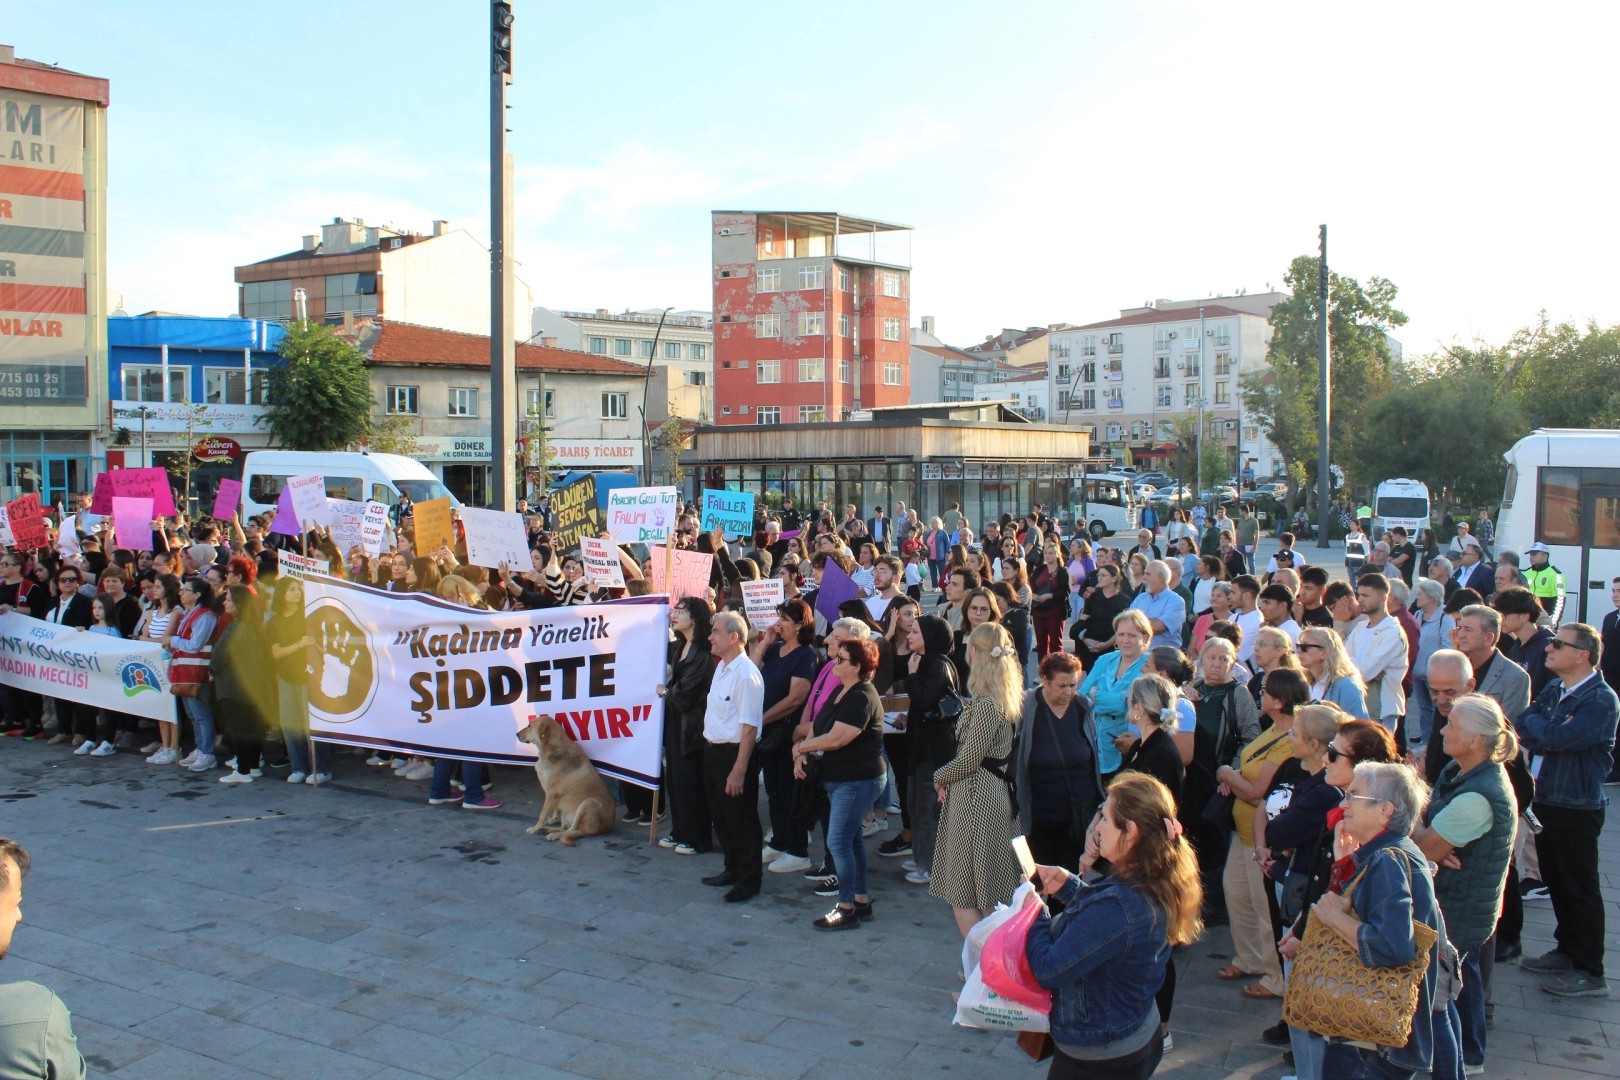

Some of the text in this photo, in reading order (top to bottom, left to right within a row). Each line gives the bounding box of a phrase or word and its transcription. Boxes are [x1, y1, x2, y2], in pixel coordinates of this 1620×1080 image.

[26, 374, 39, 384] 01
[44, 374, 58, 384] 25
[26, 388, 40, 398] 09
[45, 388, 59, 398] 42
[454, 439, 485, 451] DÖNER
[207, 448, 229, 456] Kasap
[452, 451, 473, 459] ÇORBA
[560, 446, 590, 459] BARIŞ
[594, 444, 634, 458] TİCARET
[550, 479, 594, 515] ÖLDÜREN
[660, 492, 676, 504] TUT
[607, 557, 618, 567] BİR
[29, 626, 56, 639] KEŞAN
[528, 614, 610, 647] Yönelik
[26, 641, 101, 673] KONSEYİ
[0, 657, 89, 689] KADIN MECLİSİ
[409, 652, 616, 724] ŞİDDETE
